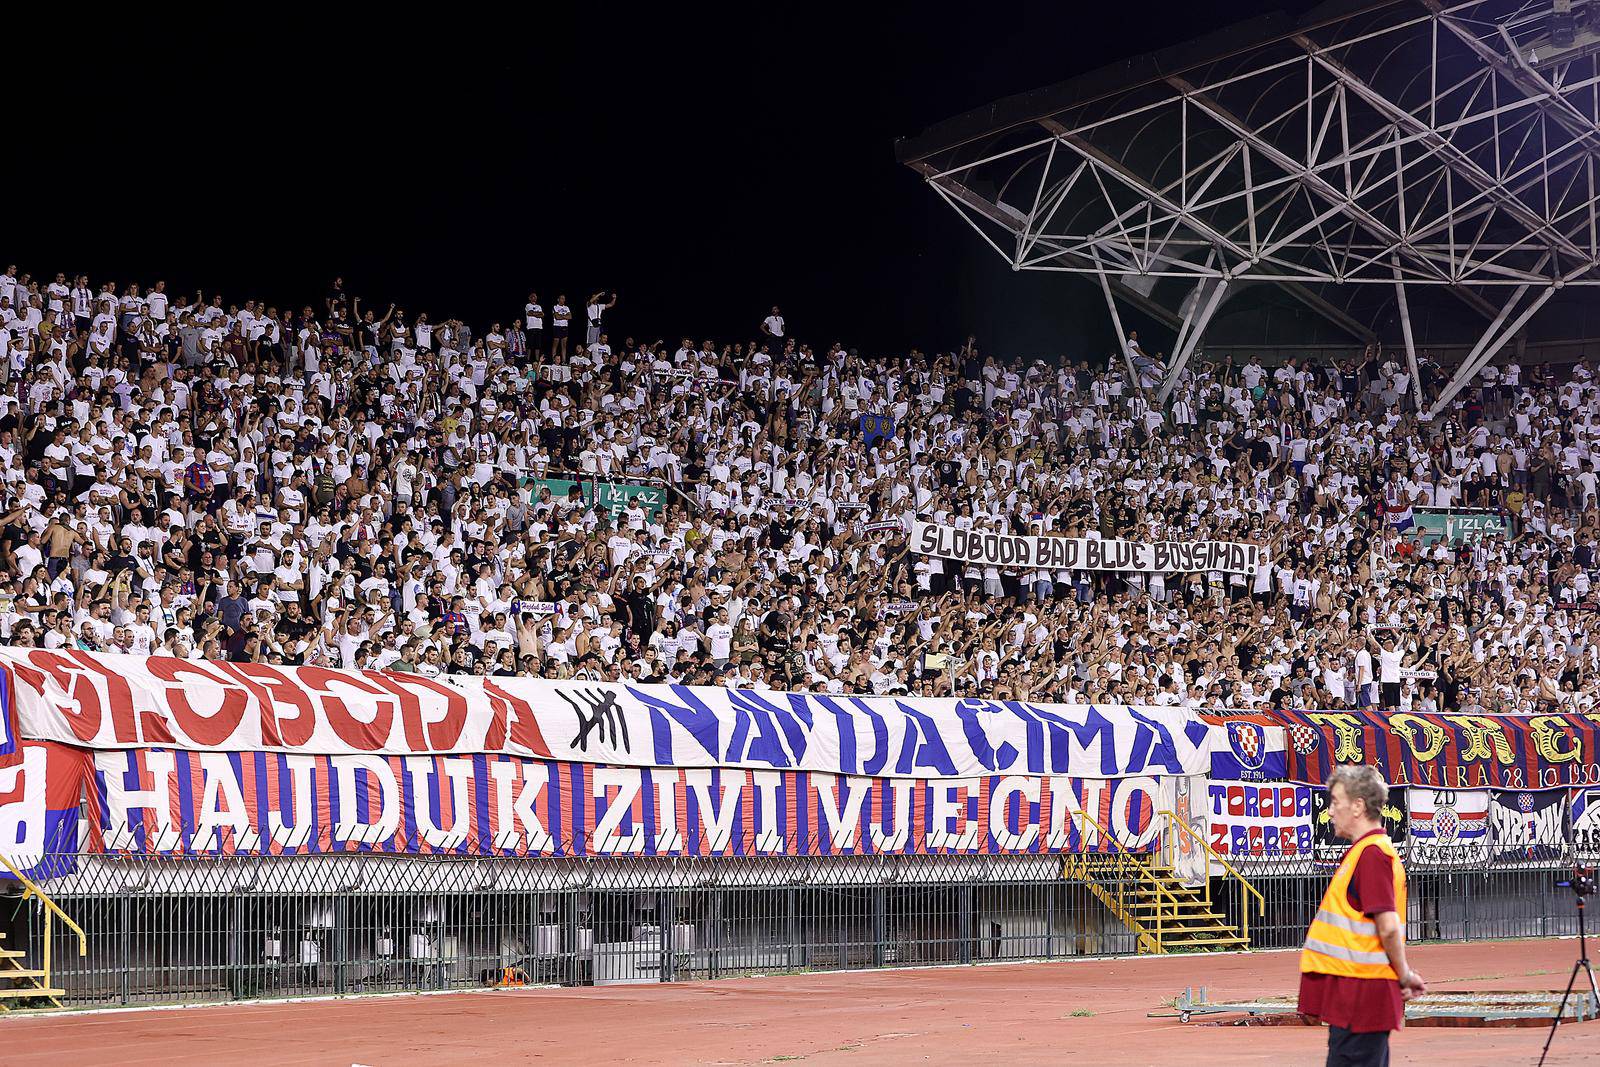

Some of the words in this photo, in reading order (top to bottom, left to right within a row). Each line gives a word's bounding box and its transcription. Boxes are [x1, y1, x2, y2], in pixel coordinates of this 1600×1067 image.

[1459, 518, 1505, 530] IZLAZ
[920, 524, 1031, 564] SLOBODA
[1036, 537, 1078, 567] BAD
[1086, 540, 1147, 570] BLUE
[1154, 541, 1256, 573] BOYSIMA!
[12, 649, 556, 758] SLOBODA
[96, 751, 555, 851] HAJDUK
[1208, 785, 1312, 818] TORCIDA
[1211, 823, 1312, 856] ZAGREB
